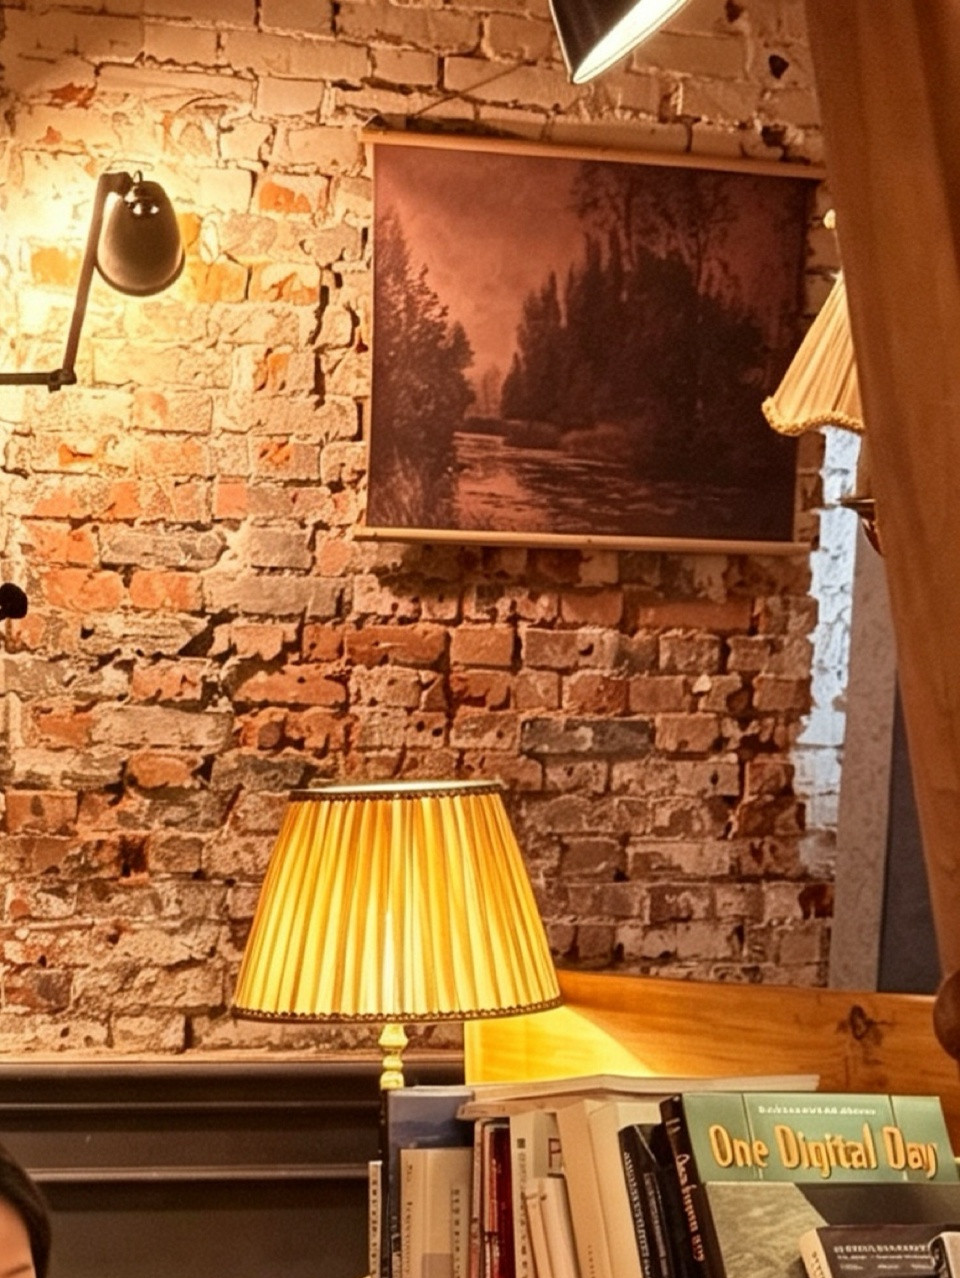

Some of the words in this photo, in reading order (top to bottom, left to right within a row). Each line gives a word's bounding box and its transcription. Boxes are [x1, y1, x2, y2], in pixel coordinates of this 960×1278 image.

[707, 1123, 770, 1168] One
[773, 1121, 878, 1179] Digital
[881, 1124, 938, 1180] Day
